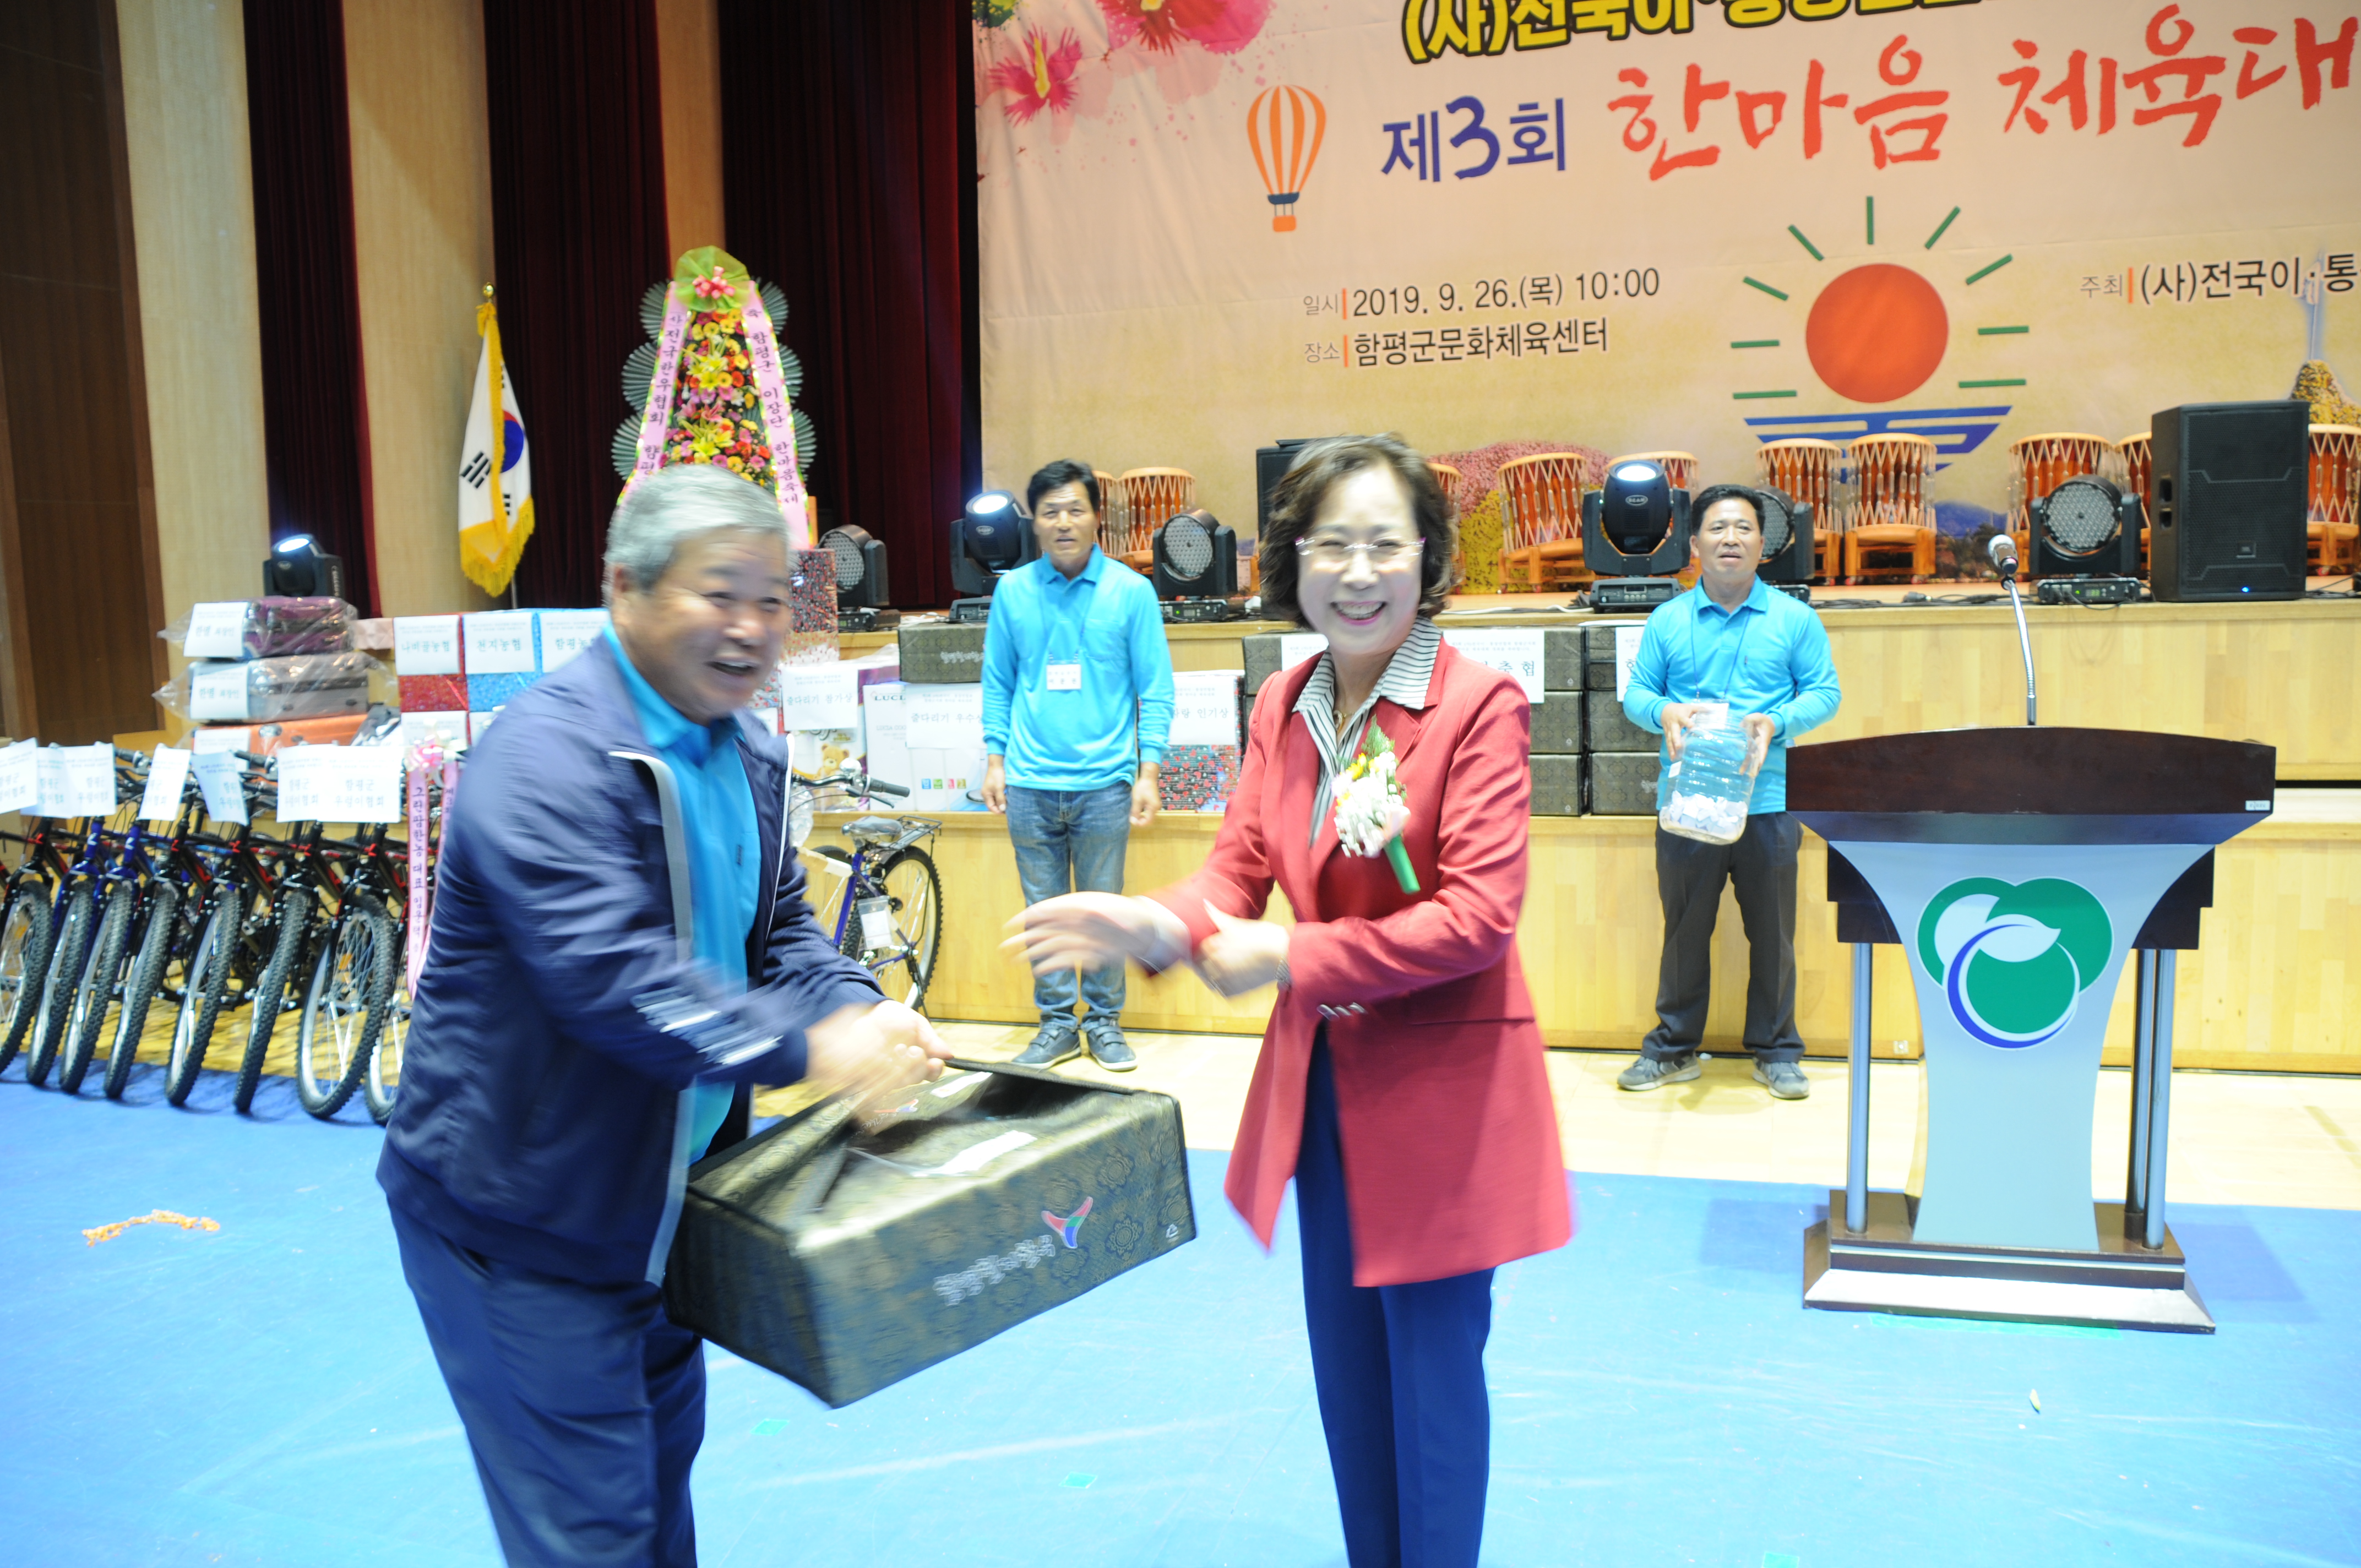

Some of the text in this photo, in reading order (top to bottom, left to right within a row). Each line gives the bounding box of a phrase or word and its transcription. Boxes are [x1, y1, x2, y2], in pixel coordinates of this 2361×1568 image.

[1381, 96, 1566, 183] 제3회
[1607, 34, 1950, 181] 한마음
[1303, 267, 1660, 317] 일시 2019. 9. 26.(목) 10:00
[2079, 274, 2123, 298] 주최
[1304, 317, 1607, 367] 장소 함평군문화체육센터
[752, 331, 775, 373] 함평군
[764, 386, 785, 428] 이장단
[911, 712, 949, 724] 줄다리기
[1196, 707, 1229, 719] 인기상
